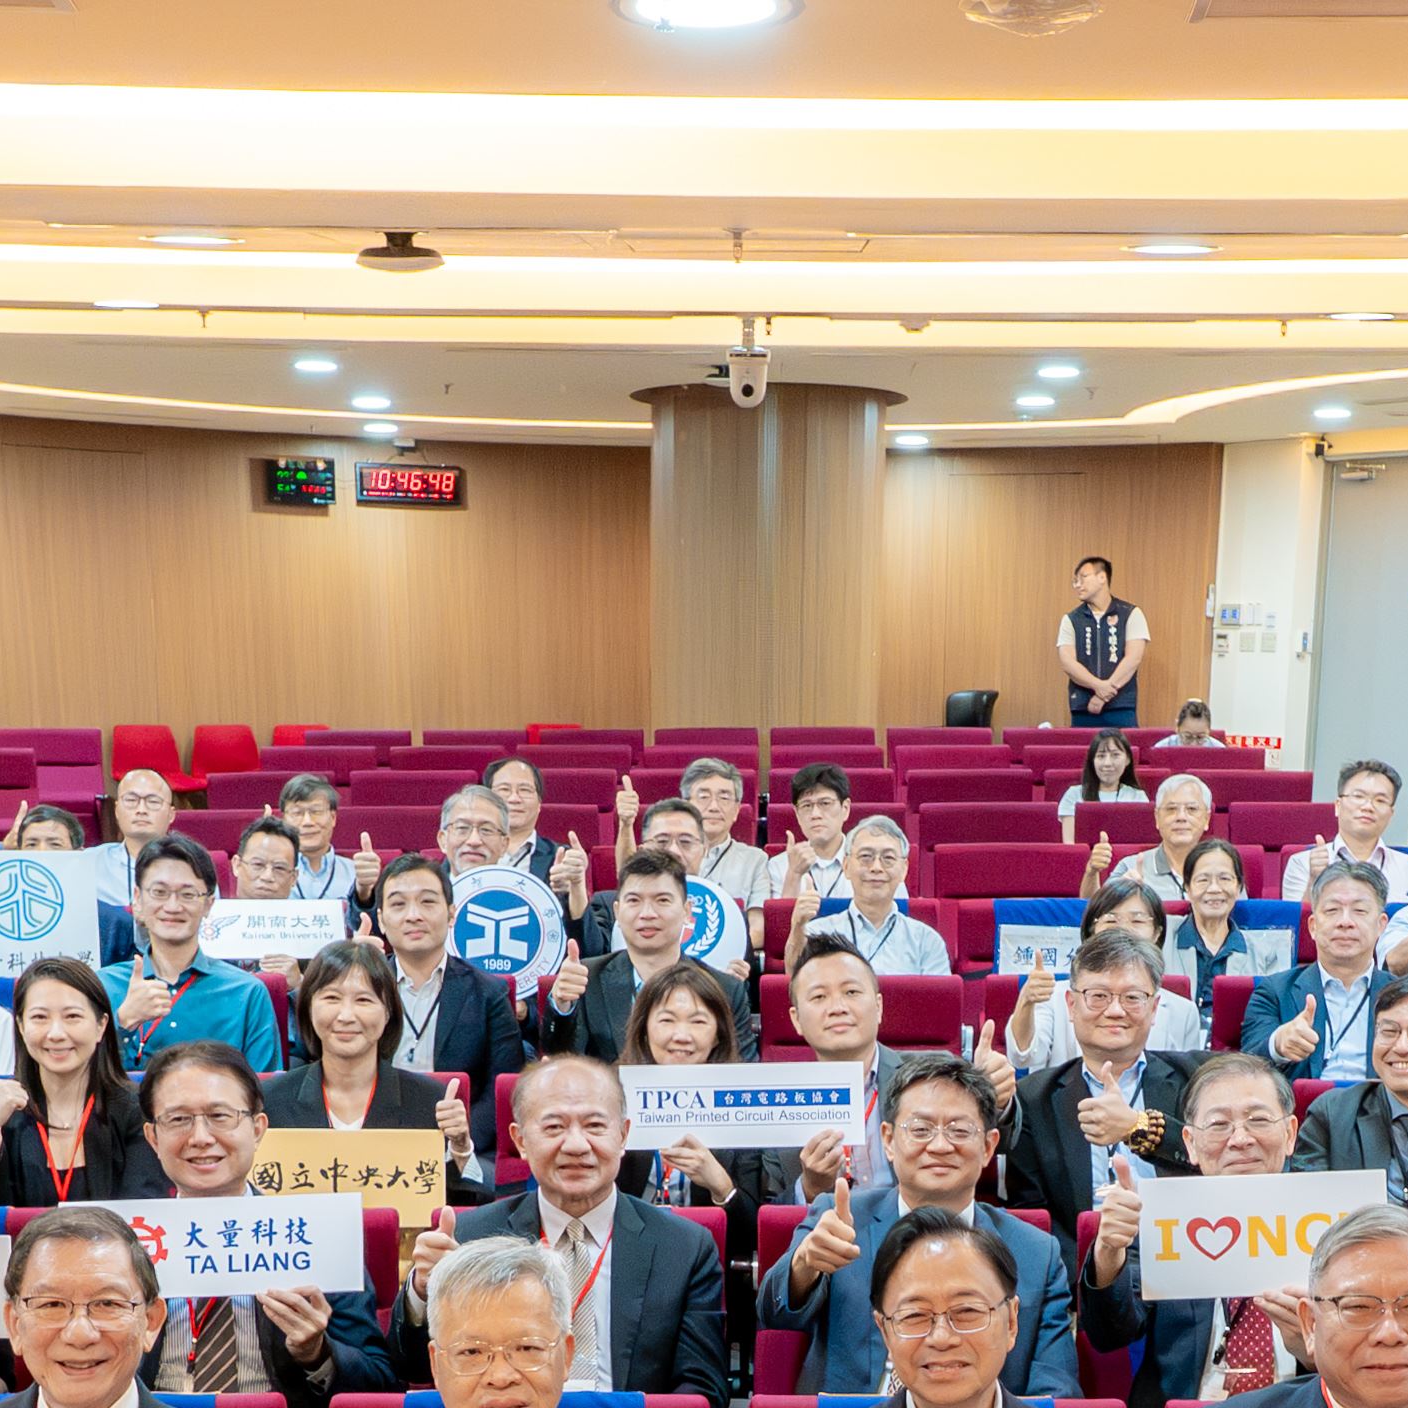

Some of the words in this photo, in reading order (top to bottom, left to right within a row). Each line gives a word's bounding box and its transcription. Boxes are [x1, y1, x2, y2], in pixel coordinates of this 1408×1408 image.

[371, 468, 455, 492] 10:46:48
[280, 931, 335, 940] University
[483, 959, 512, 971] 1989
[636, 1089, 707, 1110] TPCA
[724, 1090, 840, 1105] 台灣電路板協會
[638, 1111, 681, 1124] Taiwan
[685, 1110, 730, 1123] Printed
[734, 1109, 774, 1122] Circuit
[779, 1109, 850, 1121] Association
[252, 1157, 441, 1195] 國立中央大學
[183, 1216, 313, 1249] 大量科技
[1154, 1218, 1181, 1262] I
[1247, 1212, 1351, 1258] NC
[185, 1254, 218, 1274] TA
[227, 1251, 311, 1273] LIANG
